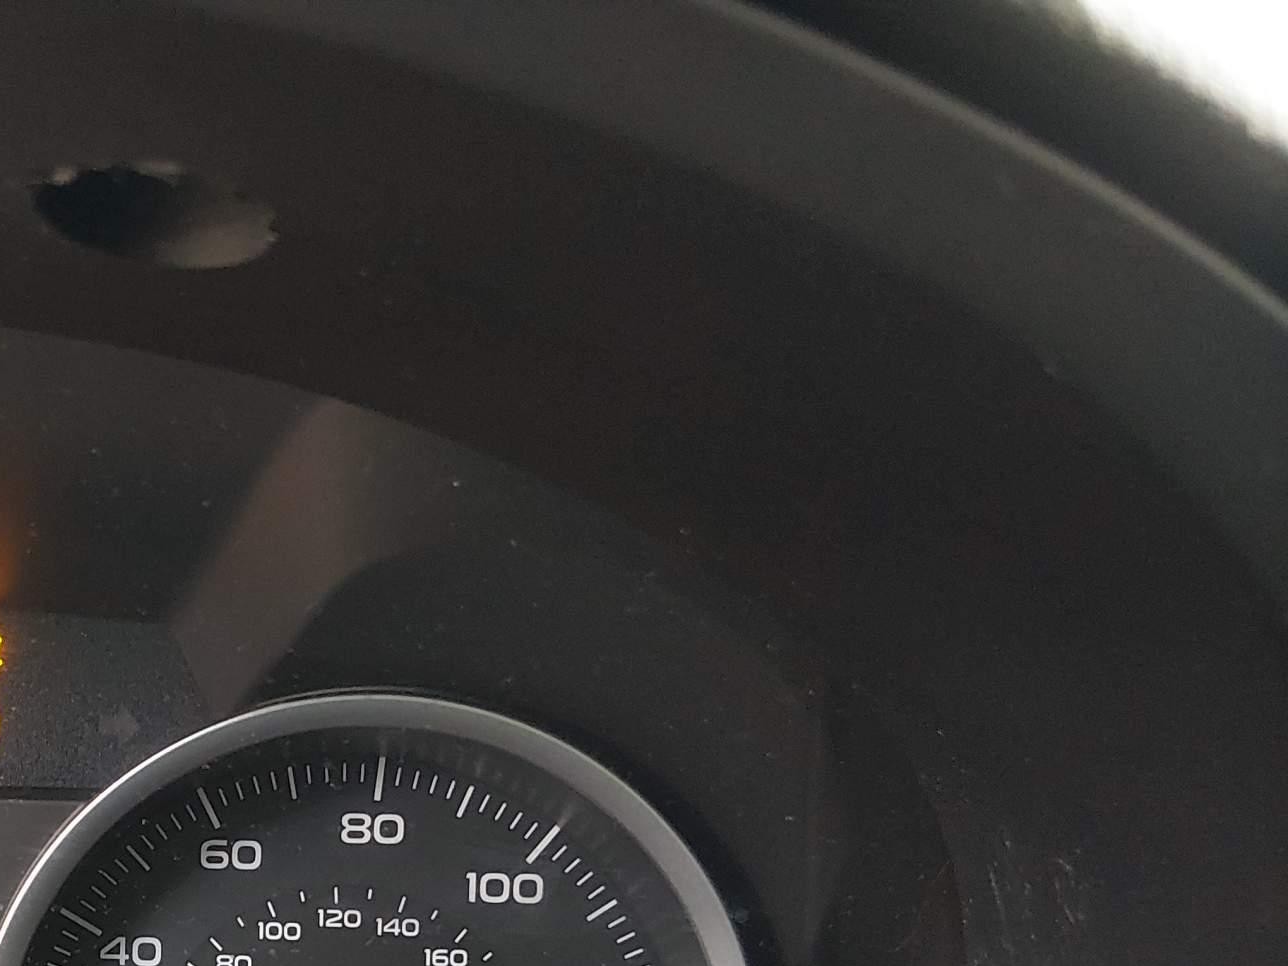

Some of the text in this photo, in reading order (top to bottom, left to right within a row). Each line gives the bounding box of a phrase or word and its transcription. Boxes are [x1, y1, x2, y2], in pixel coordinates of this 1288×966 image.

[340, 813, 405, 845] 80
[200, 839, 262, 870] 60
[465, 872, 544, 904] 100
[257, 921, 301, 941] 100
[317, 908, 362, 928] 120
[375, 917, 420, 937] 140
[99, 931, 162, 966] 40
